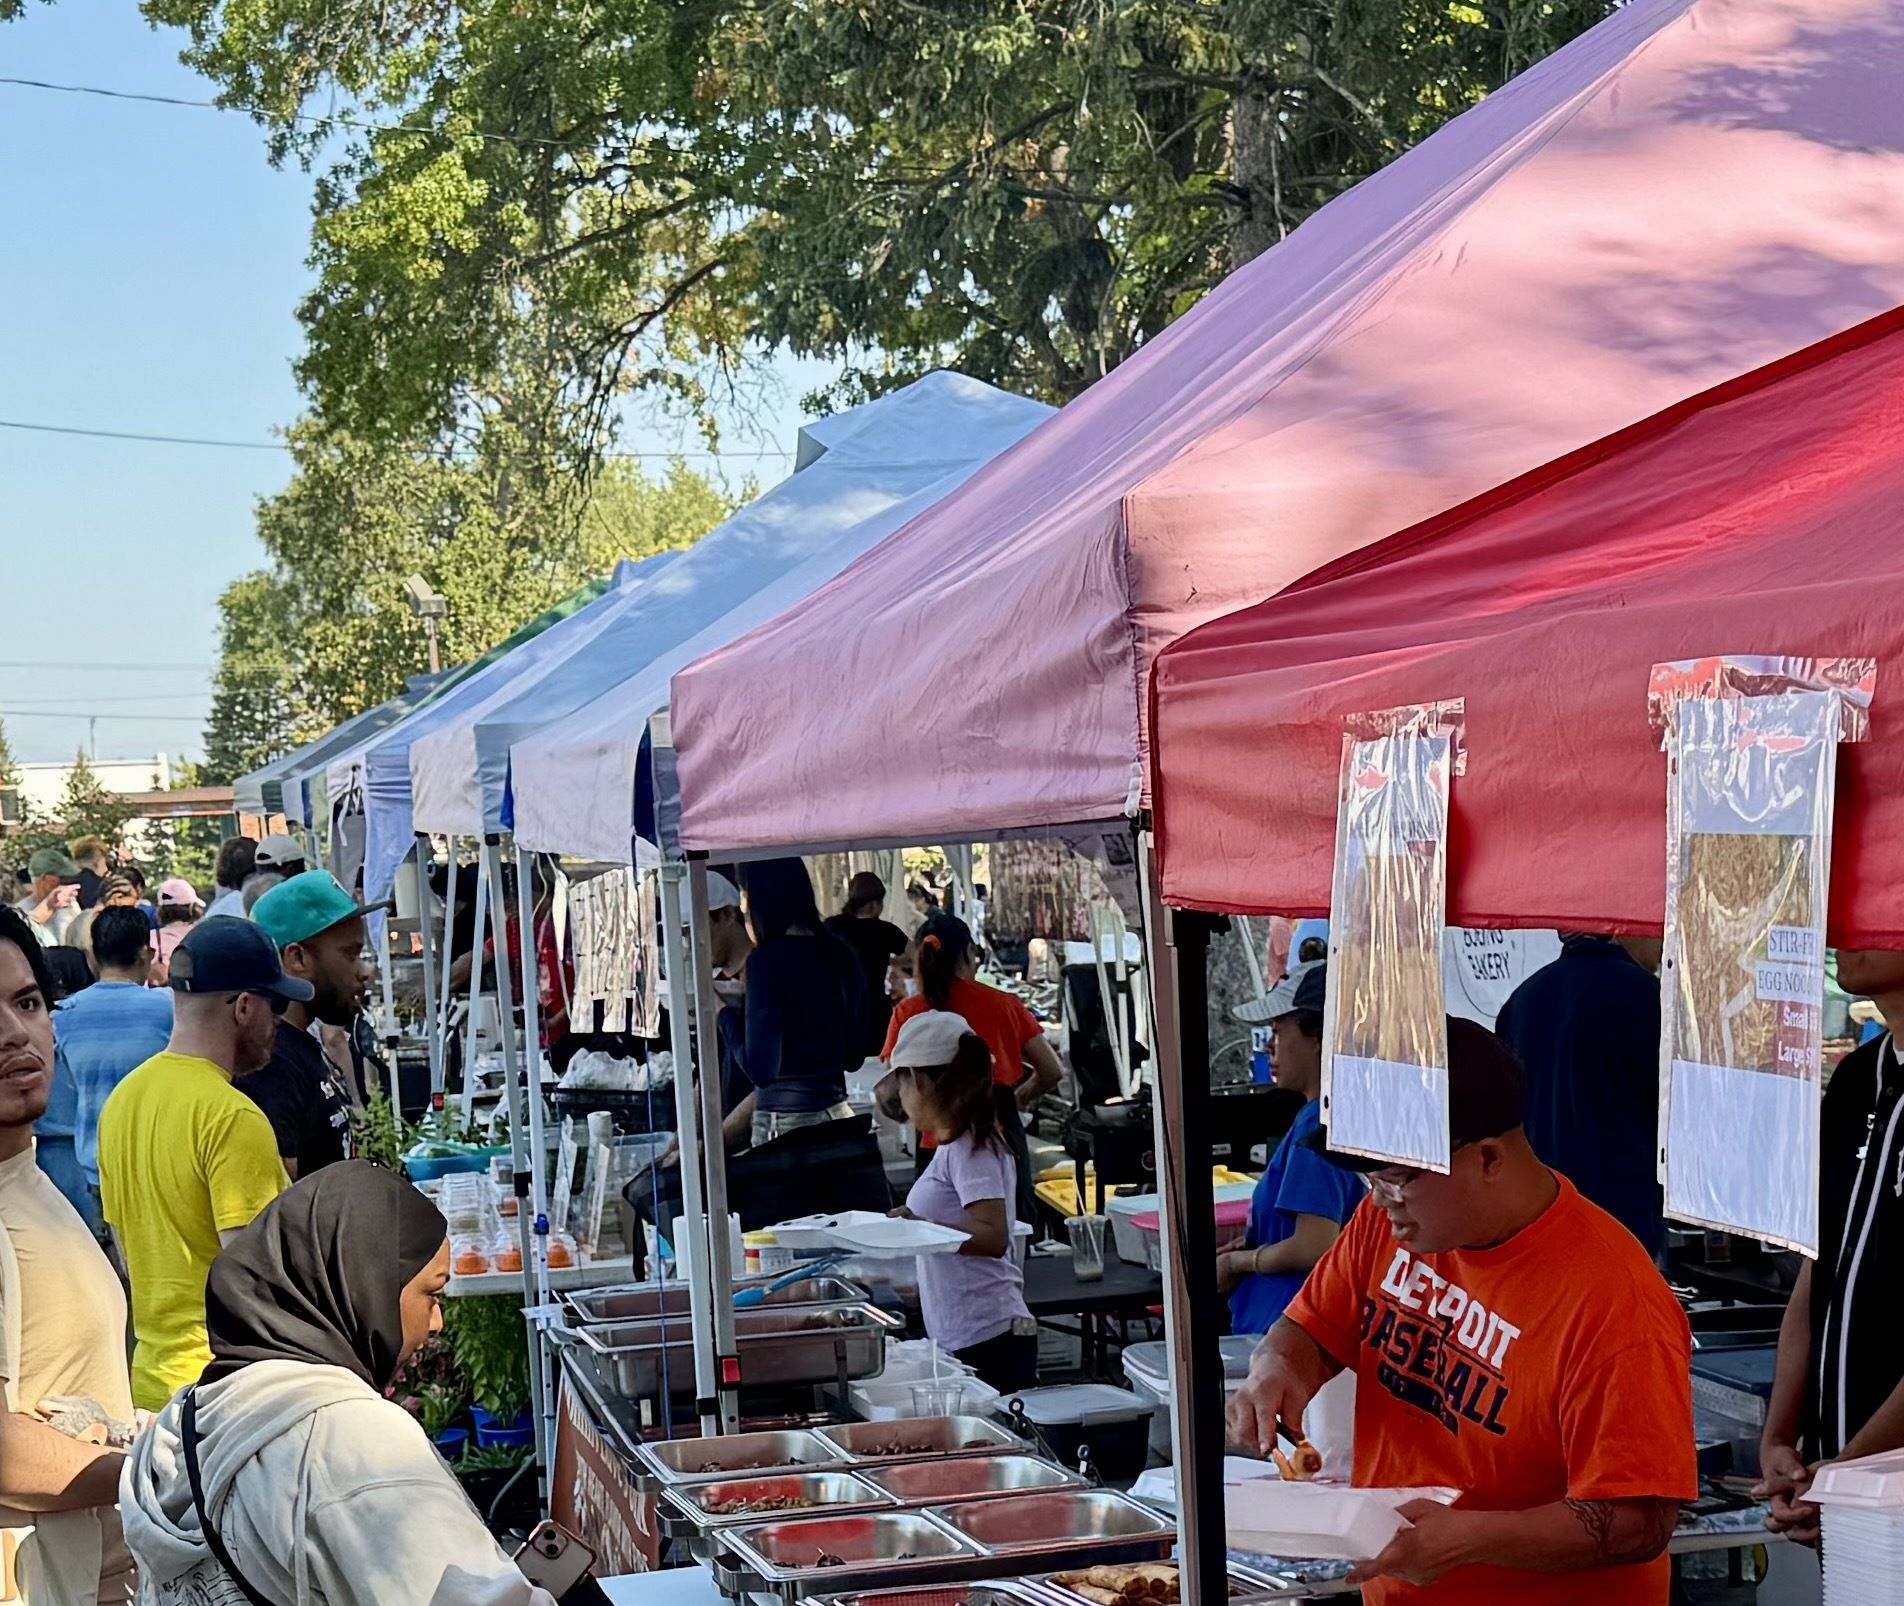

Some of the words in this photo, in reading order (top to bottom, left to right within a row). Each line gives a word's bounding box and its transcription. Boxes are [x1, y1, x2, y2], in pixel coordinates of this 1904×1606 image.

[1758, 969, 1782, 991] EGG
[1361, 1299, 1509, 1435] BASEALL
[1380, 1248, 1521, 1369] DETROIT
